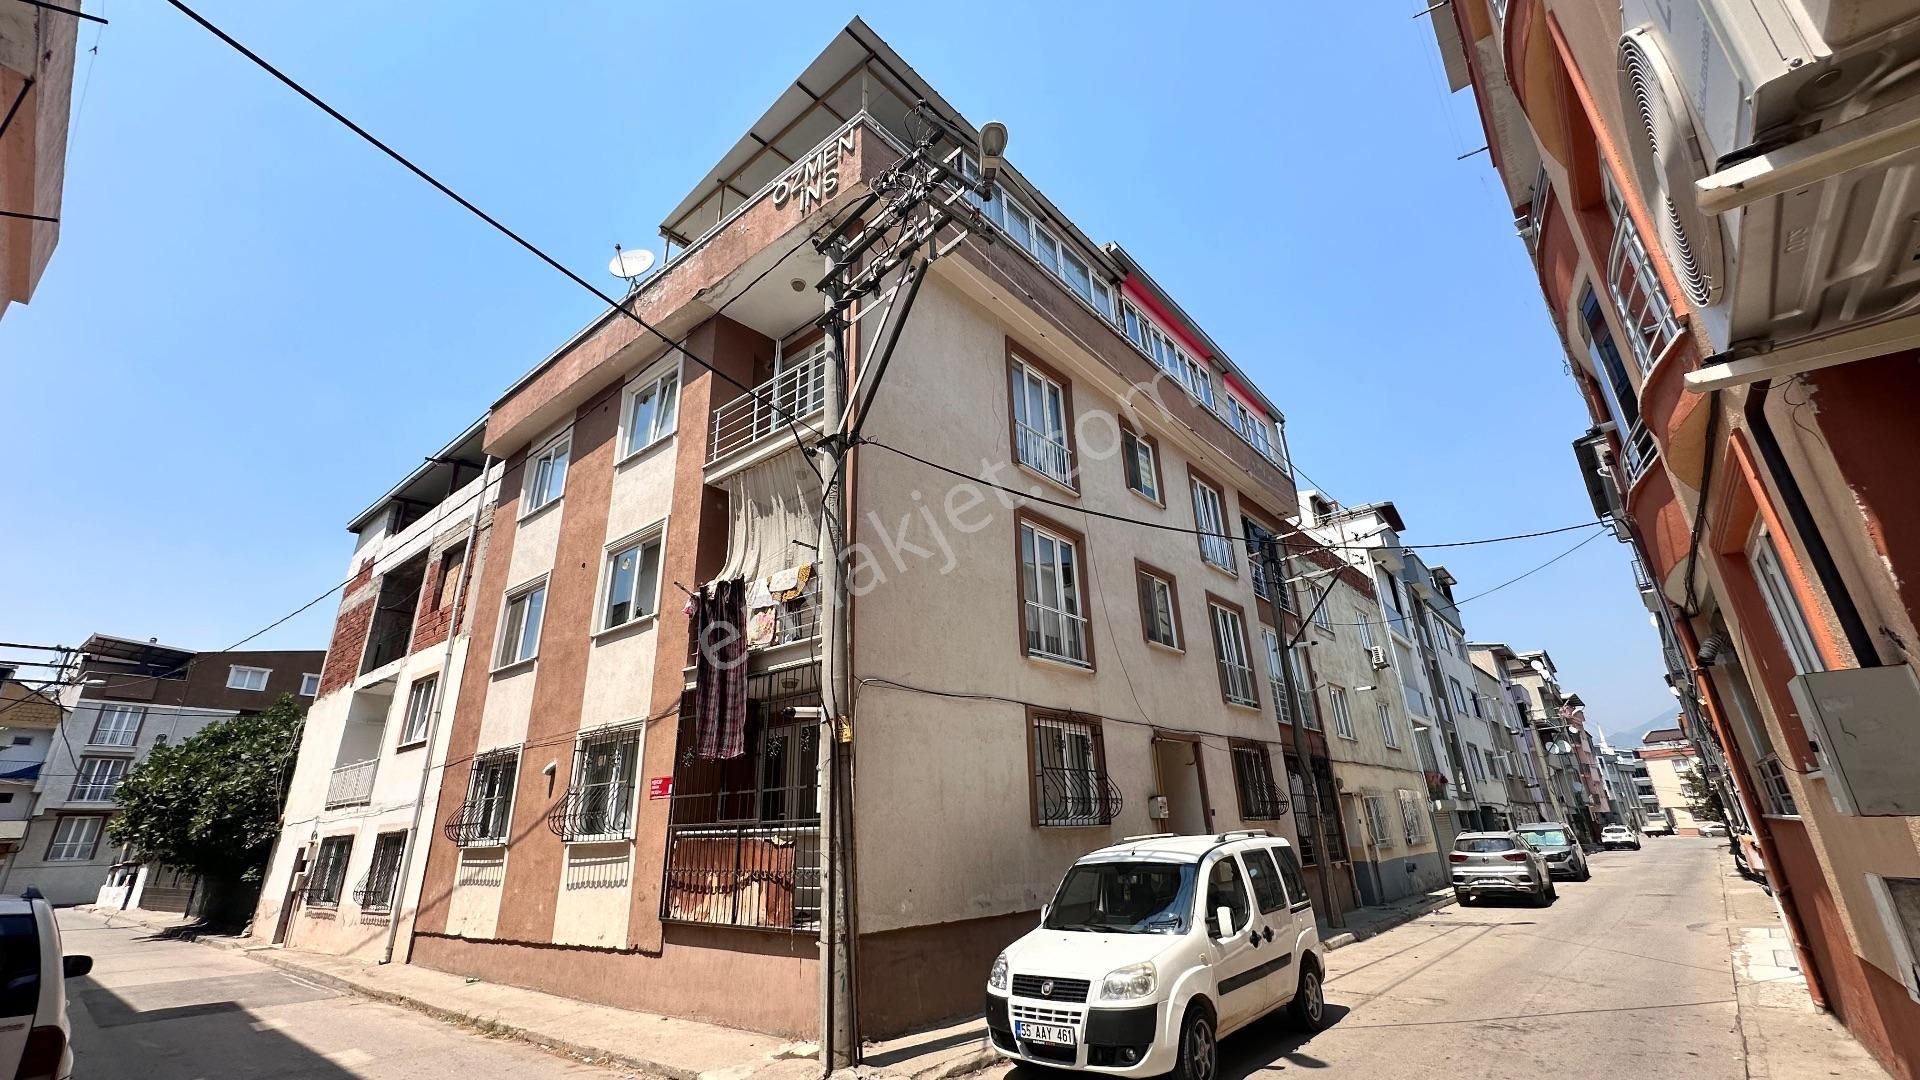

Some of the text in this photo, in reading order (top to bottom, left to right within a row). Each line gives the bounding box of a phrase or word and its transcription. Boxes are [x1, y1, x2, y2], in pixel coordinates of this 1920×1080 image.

[1021, 1023, 1031, 1037] 55
[1035, 1025, 1052, 1040] AAY
[1057, 1028, 1072, 1043] 461
